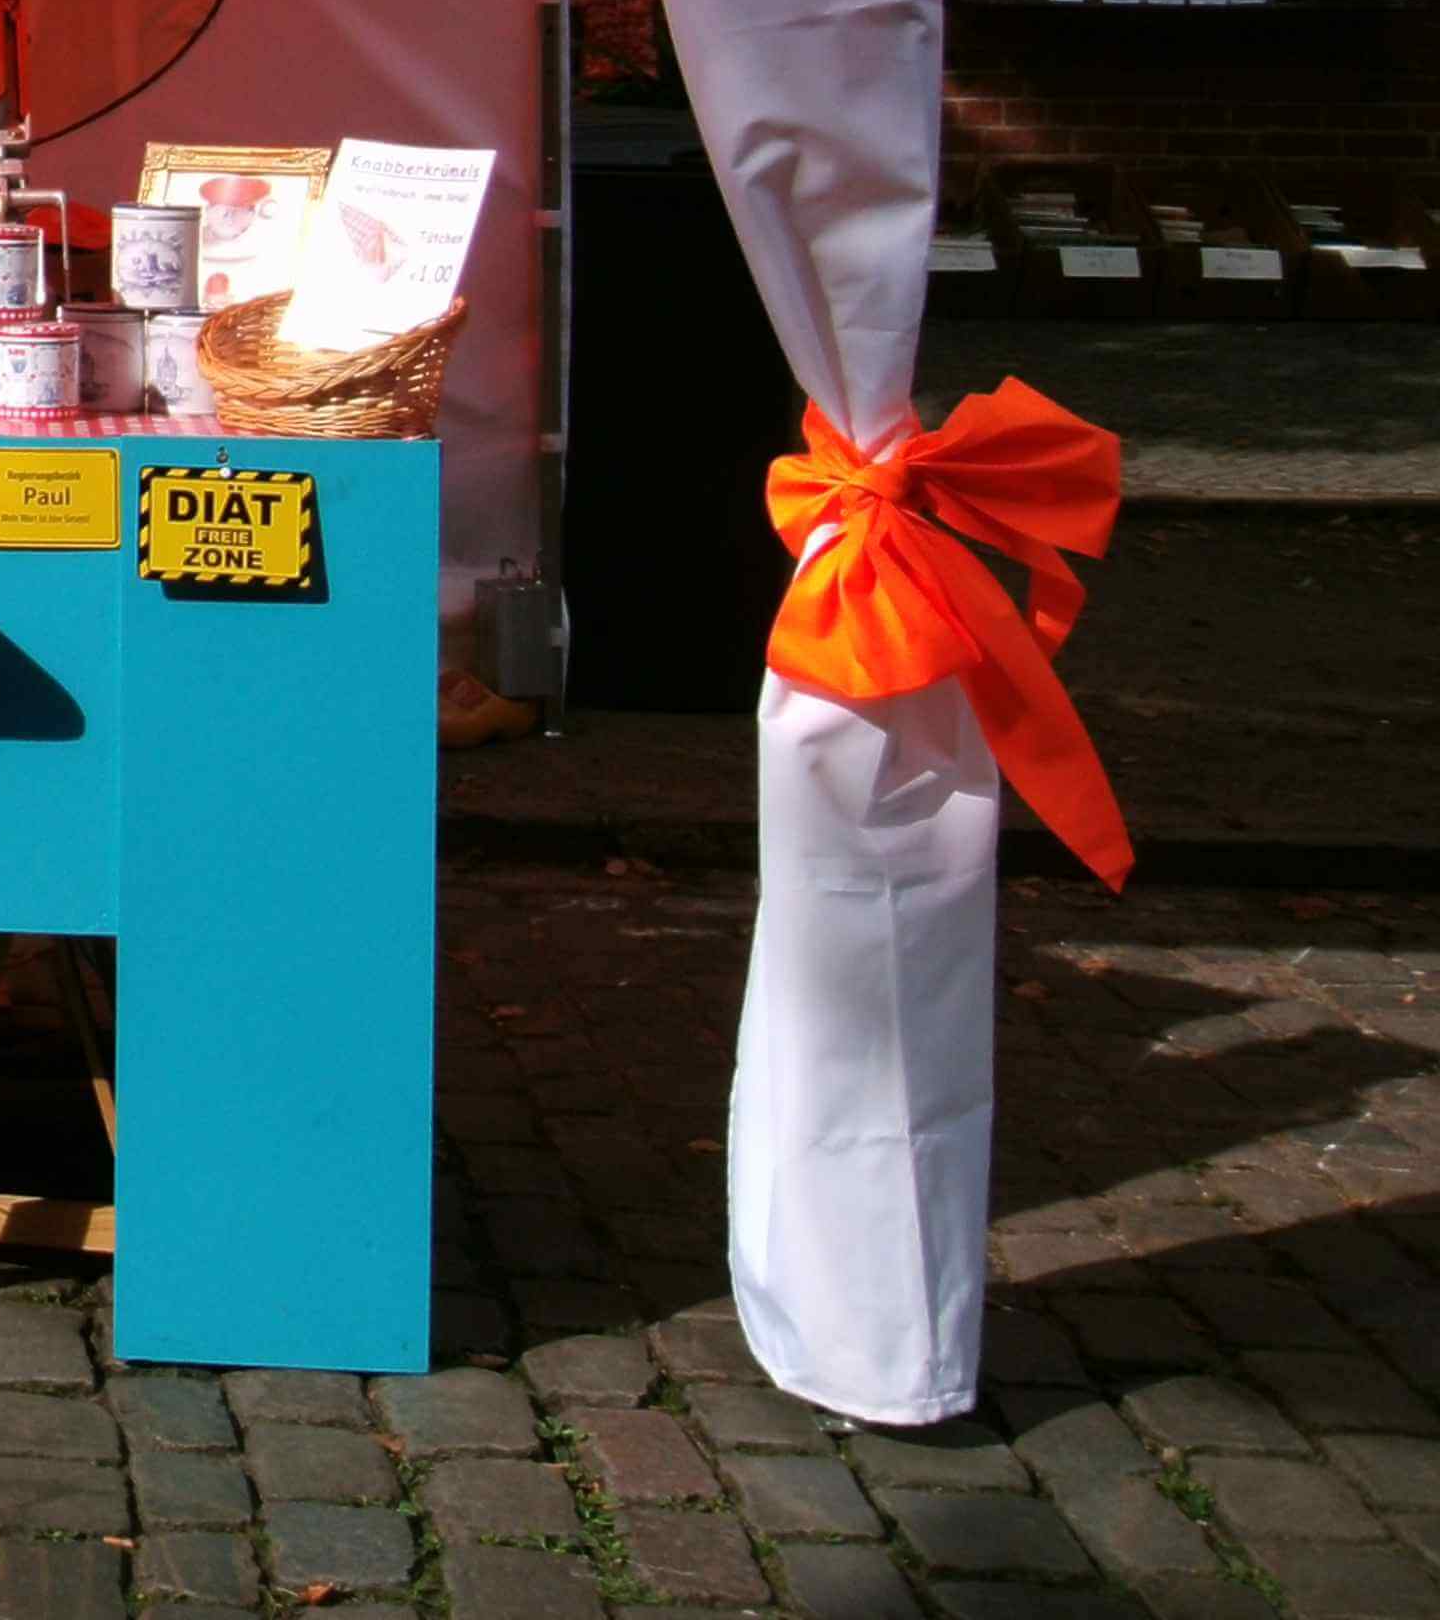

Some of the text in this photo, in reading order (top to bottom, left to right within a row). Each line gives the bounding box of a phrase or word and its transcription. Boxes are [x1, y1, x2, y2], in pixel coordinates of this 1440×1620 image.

[351, 155, 481, 178] Knabberkrümels
[24, 486, 70, 506] Paul
[166, 484, 283, 528] DIÄT
[196, 528, 251, 546] FREIE
[182, 545, 265, 570] ZONE
